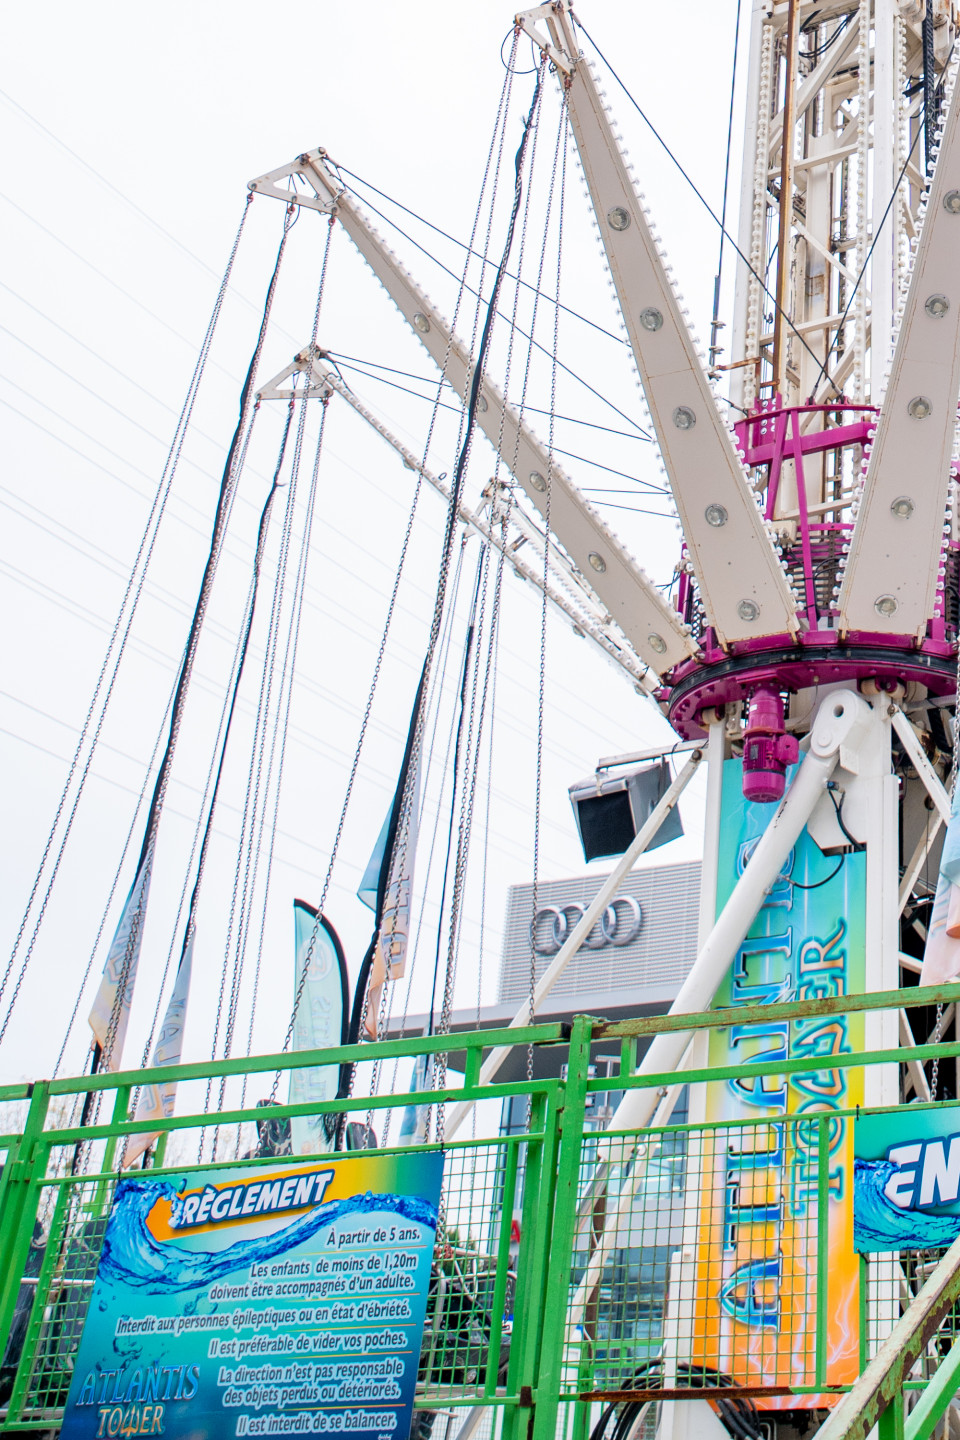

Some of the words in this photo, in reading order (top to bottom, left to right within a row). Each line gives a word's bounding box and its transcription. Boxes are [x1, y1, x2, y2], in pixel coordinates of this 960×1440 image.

[182, 1171, 333, 1225] RÈGLEMENT
[327, 1228, 337, 1245] À
[338, 1230, 371, 1248] partir
[373, 1228, 387, 1242] de
[389, 1227, 396, 1240] 5
[399, 1228, 420, 1241] ans.
[251, 1264, 268, 1277] Les
[271, 1261, 310, 1276] enfants
[316, 1259, 329, 1273] de
[332, 1258, 364, 1272] moins
[367, 1255, 380, 1269] de
[210, 1285, 249, 1300] doivent
[251, 1282, 273, 1296] être
[276, 1277, 345, 1298] accompagnés
[350, 1276, 372, 1290] d’un
[376, 1274, 414, 1288] adulte.
[117, 1317, 155, 1333] Interdit
[158, 1318, 175, 1331] aux
[177, 1315, 229, 1334] personnes
[232, 1307, 296, 1329] épileptiques
[299, 1309, 312, 1321] ou
[315, 1308, 328, 1320] en
[332, 1304, 354, 1319] état
[357, 1300, 410, 1317] d’ébriété.
[210, 1340, 218, 1355] Il
[220, 1341, 236, 1354] est
[239, 1334, 293, 1356] préférable
[296, 1335, 310, 1349] de
[313, 1333, 340, 1348] vider
[343, 1335, 362, 1347] vos
[365, 1330, 406, 1349] poches.
[76, 1358, 200, 1405] ATLANTIS
[219, 1368, 232, 1383] La
[235, 1365, 282, 1382] direction
[285, 1364, 312, 1380] n’est
[315, 1366, 333, 1382] pas
[336, 1359, 403, 1380] responsable
[224, 1389, 242, 1403] des
[245, 1387, 278, 1407] objets
[280, 1384, 318, 1405] perdus
[321, 1386, 335, 1398] ou
[338, 1379, 400, 1398] détériorés.
[98, 1404, 164, 1437] TOWER
[238, 1418, 247, 1433] Il
[249, 1418, 265, 1432] est
[268, 1414, 310, 1431] interdit
[313, 1415, 327, 1429] de
[329, 1416, 341, 1429] se
[344, 1411, 396, 1428] balancer.
